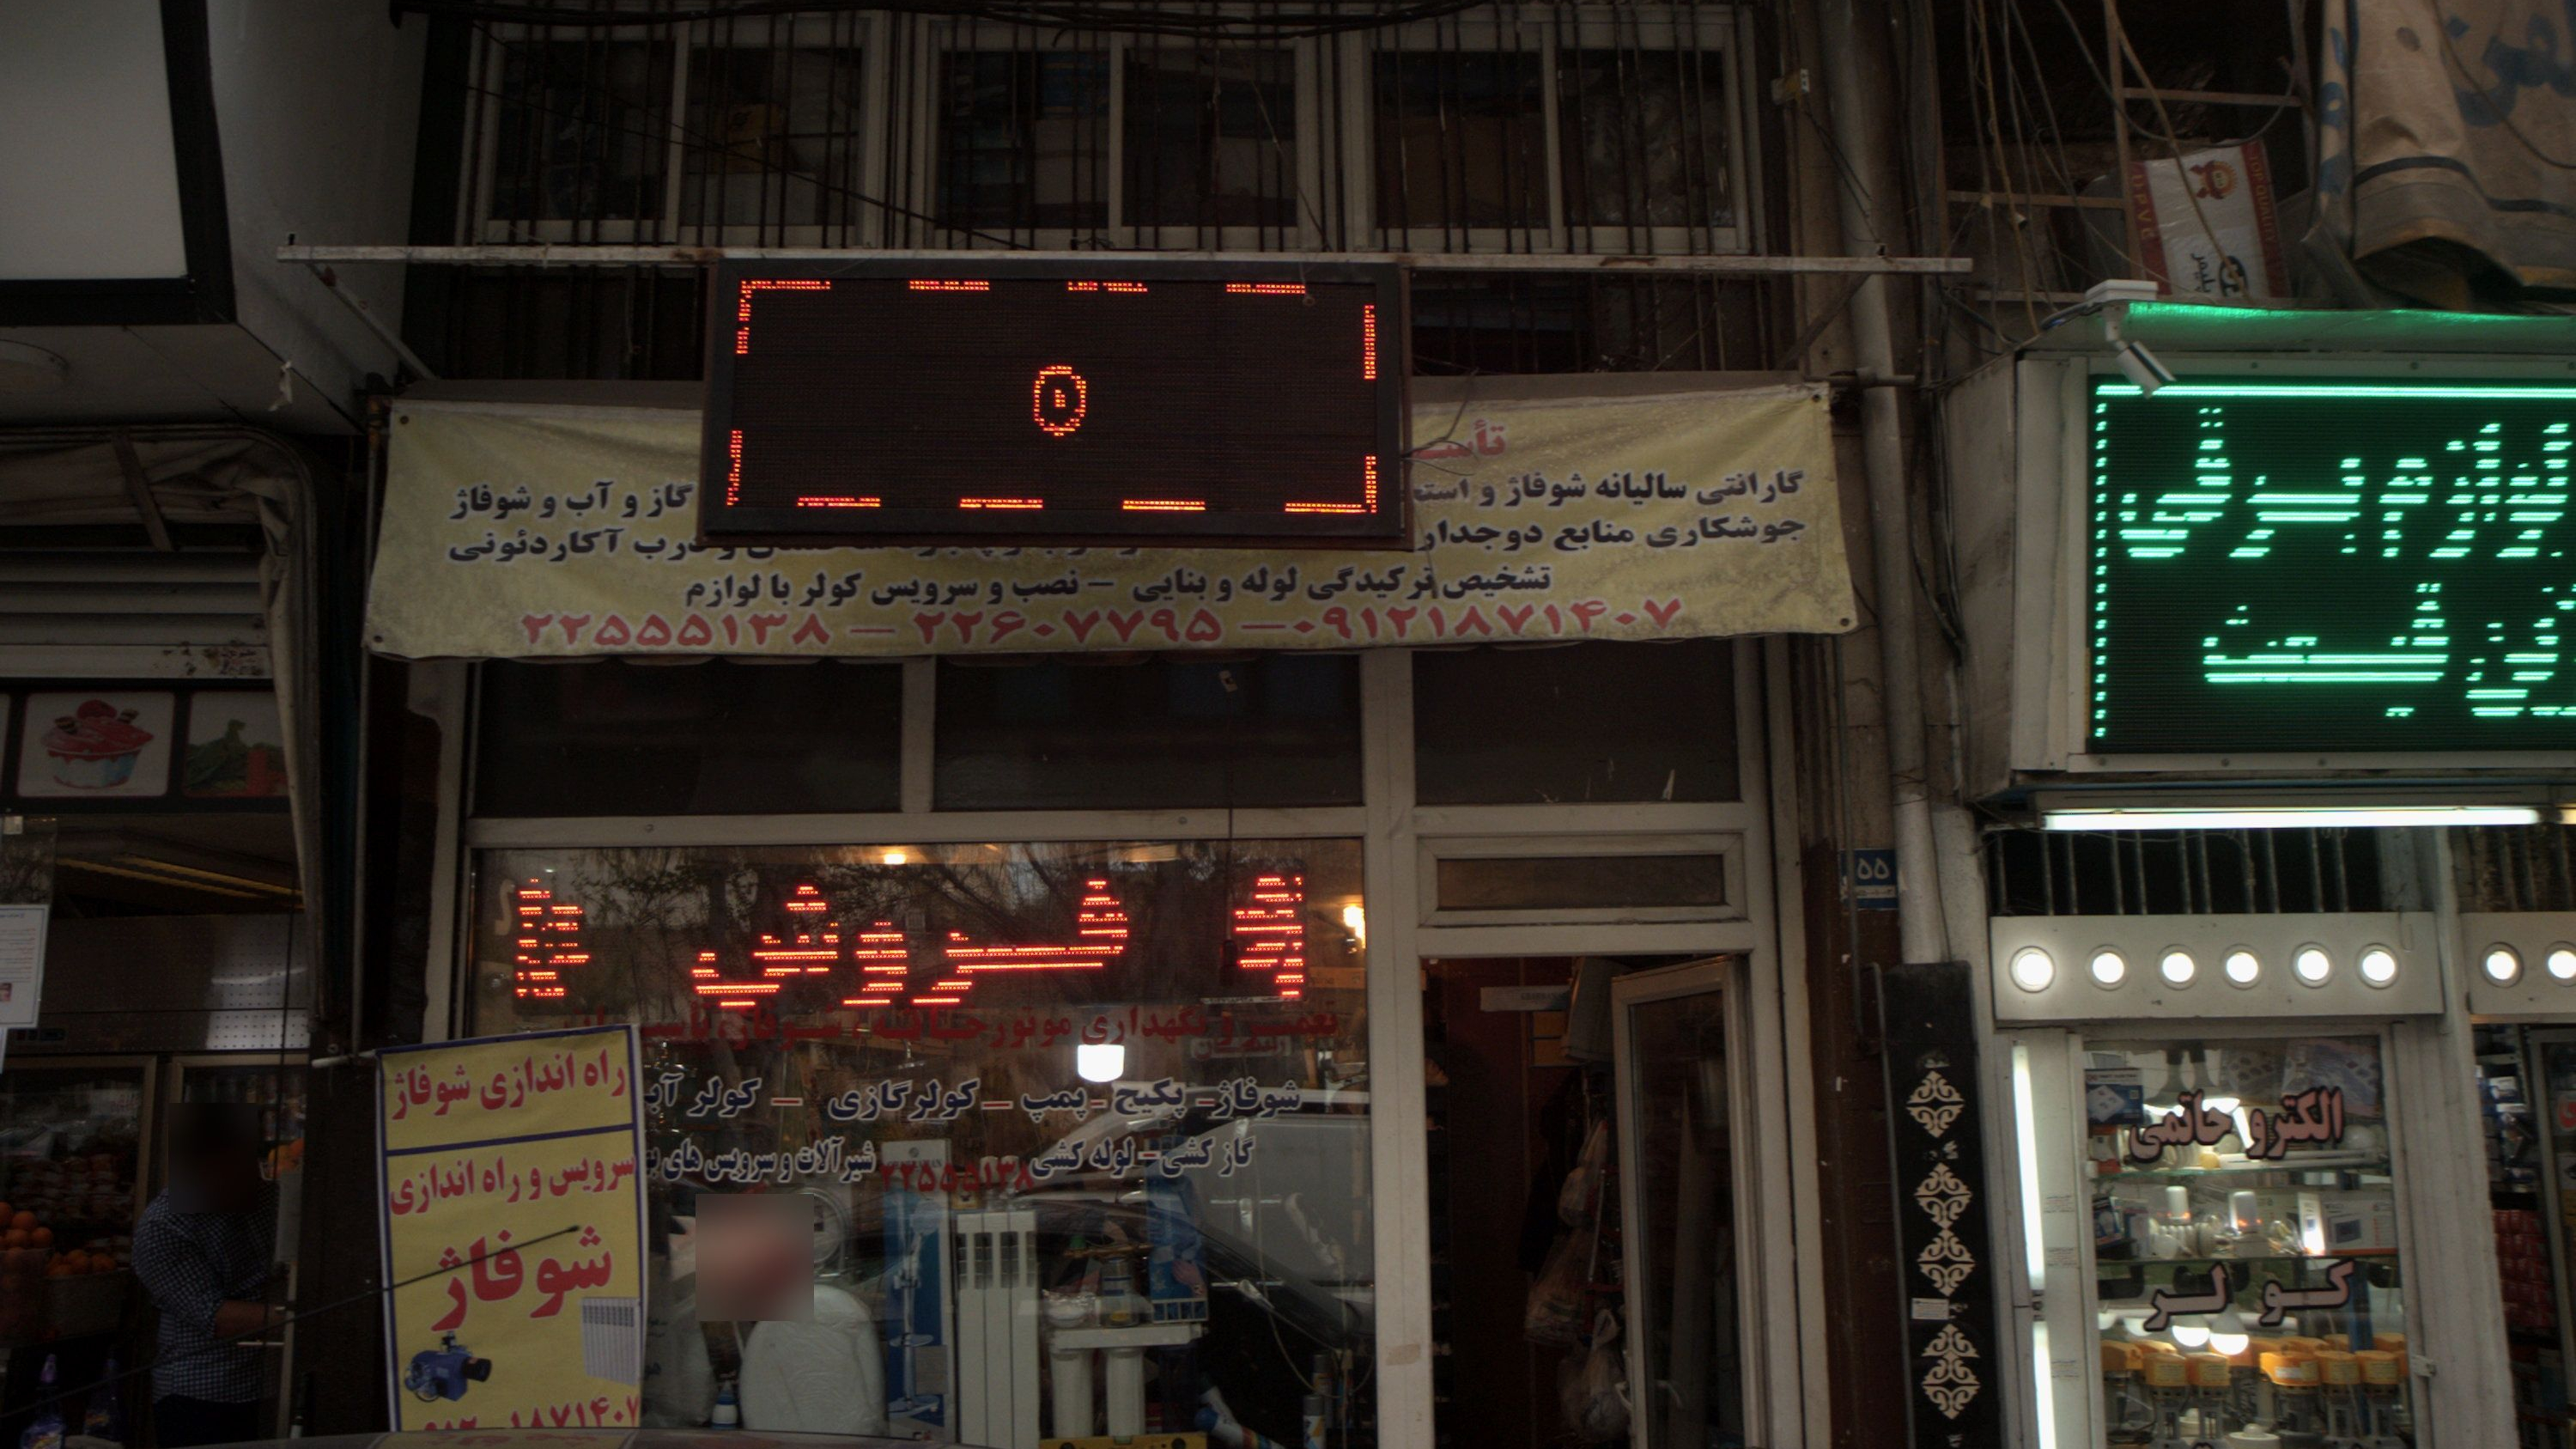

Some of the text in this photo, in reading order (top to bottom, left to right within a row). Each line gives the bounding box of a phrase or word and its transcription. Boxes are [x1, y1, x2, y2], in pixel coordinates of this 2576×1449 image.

[2129, 174, 2154, 240] UPVC
[2253, 184, 2277, 244] QUALITY
[449, 481, 693, 521] گاز و آب و شوفاژ
[1479, 485, 1495, 507] و
[1504, 472, 1586, 508] شوفاژ
[1595, 472, 1686, 500] سالیانه
[1697, 469, 1804, 507] گارانتی
[1553, 521, 1633, 552] منابع
[1646, 515, 1806, 548] جوشکاری
[686, 565, 1551, 606] تشخیص ترکیدگی لوله و بنایی نصب و سرویس کولر با لوازم
[521, 598, 1681, 646] ۰۹۱۲۱۸۷۱۴۰۷ ۲۲۶۰۷۷۹۵ ۲۲۵۵۵۱۳۸
[1857, 857, 1889, 880] ۵۵
[1082, 1005, 1208, 1044] نگهداری
[1242, 1001, 1339, 1048] تعمیر
[392, 1048, 625, 1120] راه اندازی شوفاژ
[686, 1075, 762, 1117] کولر
[1112, 1077, 1187, 1117] پکیج
[1206, 1076, 1302, 1119] شوفاژ
[1020, 1088, 1091, 1123] پمپ
[483, 1155, 520, 1203] راه
[550, 1156, 635, 1197] سرویس
[661, 1136, 704, 1182] های
[705, 1146, 776, 1183] سرویس
[879, 1160, 1035, 1193] ۲۲۵۵۵۱۳۸
[390, 1158, 475, 1215] اندازی
[528, 1166, 542, 1201] و
[431, 1225, 612, 1331] شوفاژ
